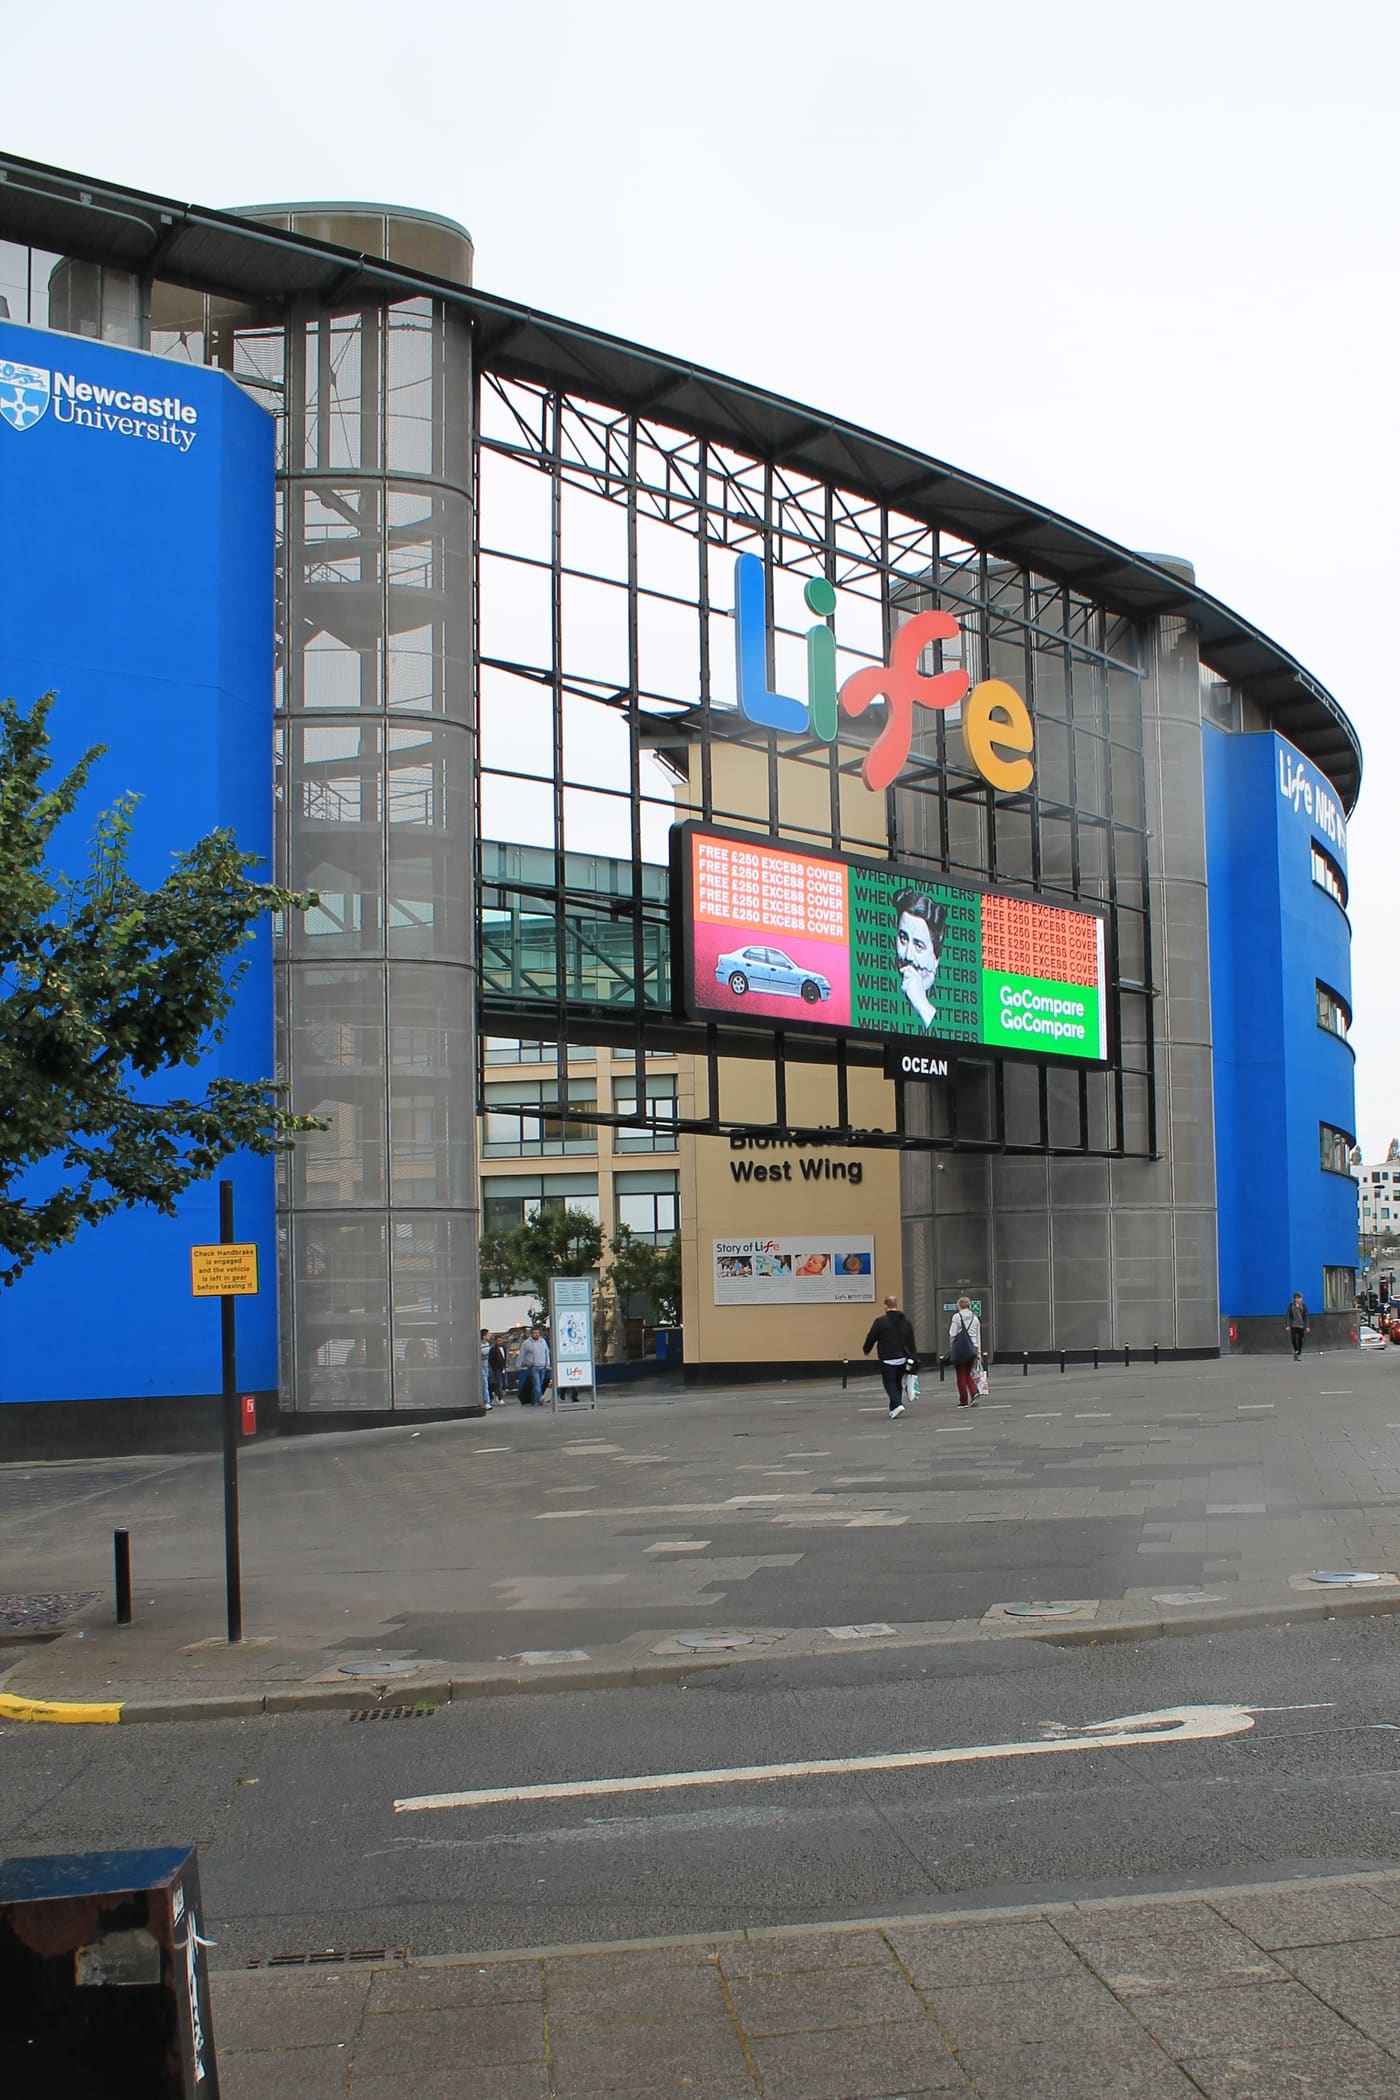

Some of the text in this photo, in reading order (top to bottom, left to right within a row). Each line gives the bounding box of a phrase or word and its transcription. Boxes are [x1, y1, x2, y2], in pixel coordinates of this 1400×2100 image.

[54, 372, 197, 424] Newcastle
[52, 395, 196, 452] University
[735, 552, 1034, 792] Life
[1280, 750, 1336, 842] Life NHS
[699, 844, 842, 883] FREE £250 EXCESS COVER
[699, 859, 842, 897] FREE £250 EXCESS COVER
[856, 868, 895, 886] WHEN
[699, 873, 842, 910] FREE £250 EXCESS COVER
[700, 888, 843, 923] FREE £250 EXCESS COVER
[855, 908, 897, 929] WHEN
[981, 894, 1004, 908] FREE
[1008, 898, 1029, 913] £250
[1032, 904, 1066, 920] EXCESS
[700, 902, 843, 936] FREE £250 EXCESS COVER
[981, 907, 1004, 921] FREE
[1008, 912, 1029, 925] £250
[1032, 918, 1066, 933] EXCESS
[856, 929, 897, 950] WHEN
[981, 920, 1005, 933] FREE
[1008, 925, 1029, 938] £250
[1032, 930, 1066, 945] EXCESS
[981, 933, 1005, 946] FREE
[1008, 938, 1030, 951] £250
[1033, 943, 1067, 958] EXCESS
[857, 952, 899, 971] WHEN
[982, 946, 1005, 959] FREE
[1008, 951, 1030, 963] £250
[1033, 956, 1067, 971] EXCESS
[982, 959, 1005, 972] FREE
[1008, 963, 1030, 976] £250
[1033, 968, 1067, 983] EXCESS
[857, 973, 978, 1005] WHEN ATTERS
[1000, 986, 1084, 1017] GoCompare
[857, 995, 898, 1015] WHEN
[858, 1016, 898, 1033] WHEN
[902, 1023, 914, 1035] IT
[1001, 1010, 1085, 1040] GoCompare
[901, 1056, 948, 1076] OCEAN
[730, 1158, 863, 1184] West Wing
[717, 1241, 779, 1254] Story of Life
